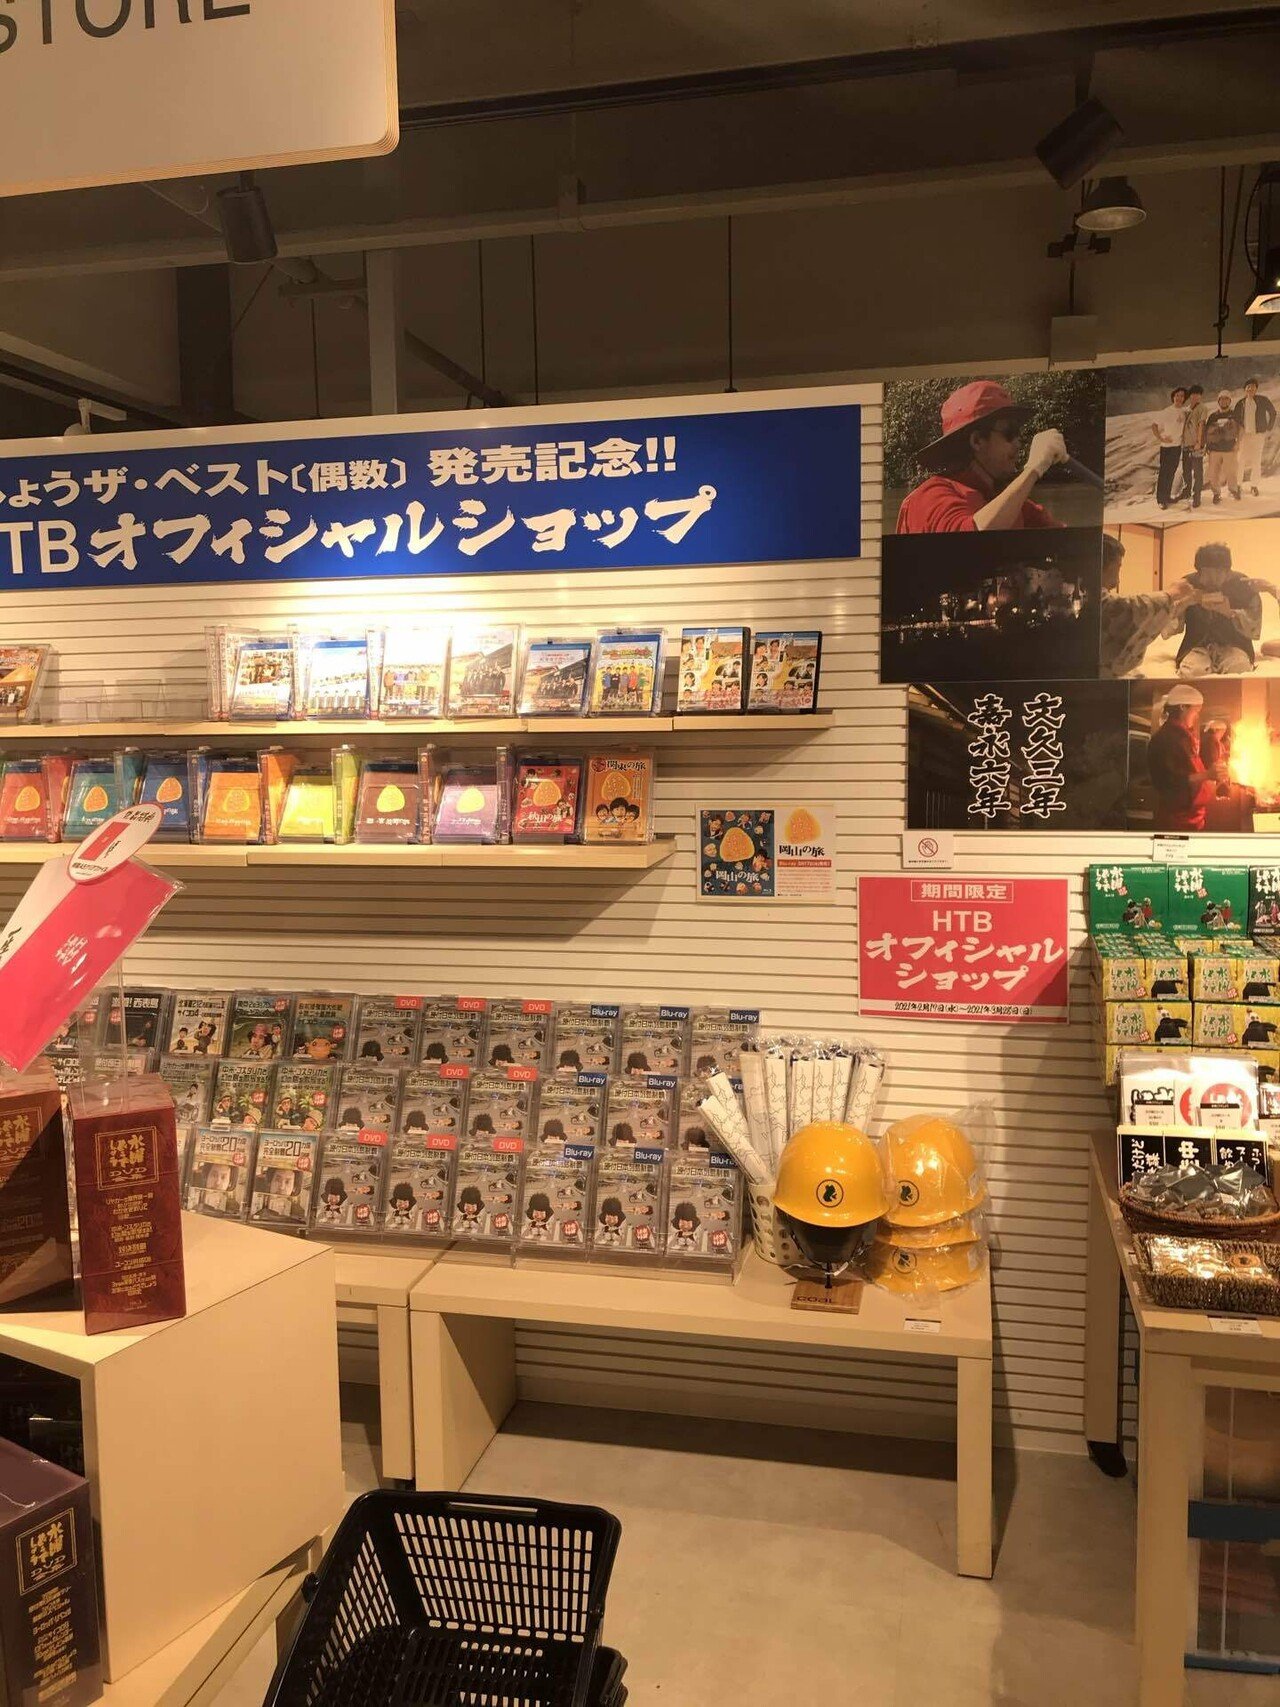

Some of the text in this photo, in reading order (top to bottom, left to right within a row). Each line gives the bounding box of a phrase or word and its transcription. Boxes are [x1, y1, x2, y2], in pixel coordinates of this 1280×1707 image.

[967, 693, 1012, 818] 嘉永六年
[1020, 692, 1067, 819] 文久三年
[779, 845, 825, 858] 岡山の旅
[715, 870, 760, 883] 岡山の旅
[921, 883, 1007, 900] 期間限定
[932, 910, 993, 933] HTB
[865, 932, 1064, 963] オフィシャル
[895, 963, 1029, 991] ショップ
[400, 999, 417, 1007] DVD
[463, 1001, 480, 1009] DVD
[528, 1003, 545, 1011] DVD
[592, 1007, 619, 1017] Blu-ray
[661, 1009, 688, 1019] Blu-ray
[731, 1012, 758, 1022] Blu-ray
[446, 1068, 463, 1076] DVD
[514, 1070, 531, 1078] DVD
[578, 1075, 606, 1085] Blu-ray
[649, 1077, 676, 1088] Blu-ray
[364, 1133, 381, 1142] DVD
[432, 1137, 450, 1146] DVD
[499, 1141, 517, 1149] DVD
[565, 1148, 593, 1158] Blu-ray
[635, 1151, 662, 1161] Blu-ray
[711, 1156, 737, 1166] Blu-r
[109, 1166, 147, 1177] DVD
[30, 1555, 66, 1578] DVD
